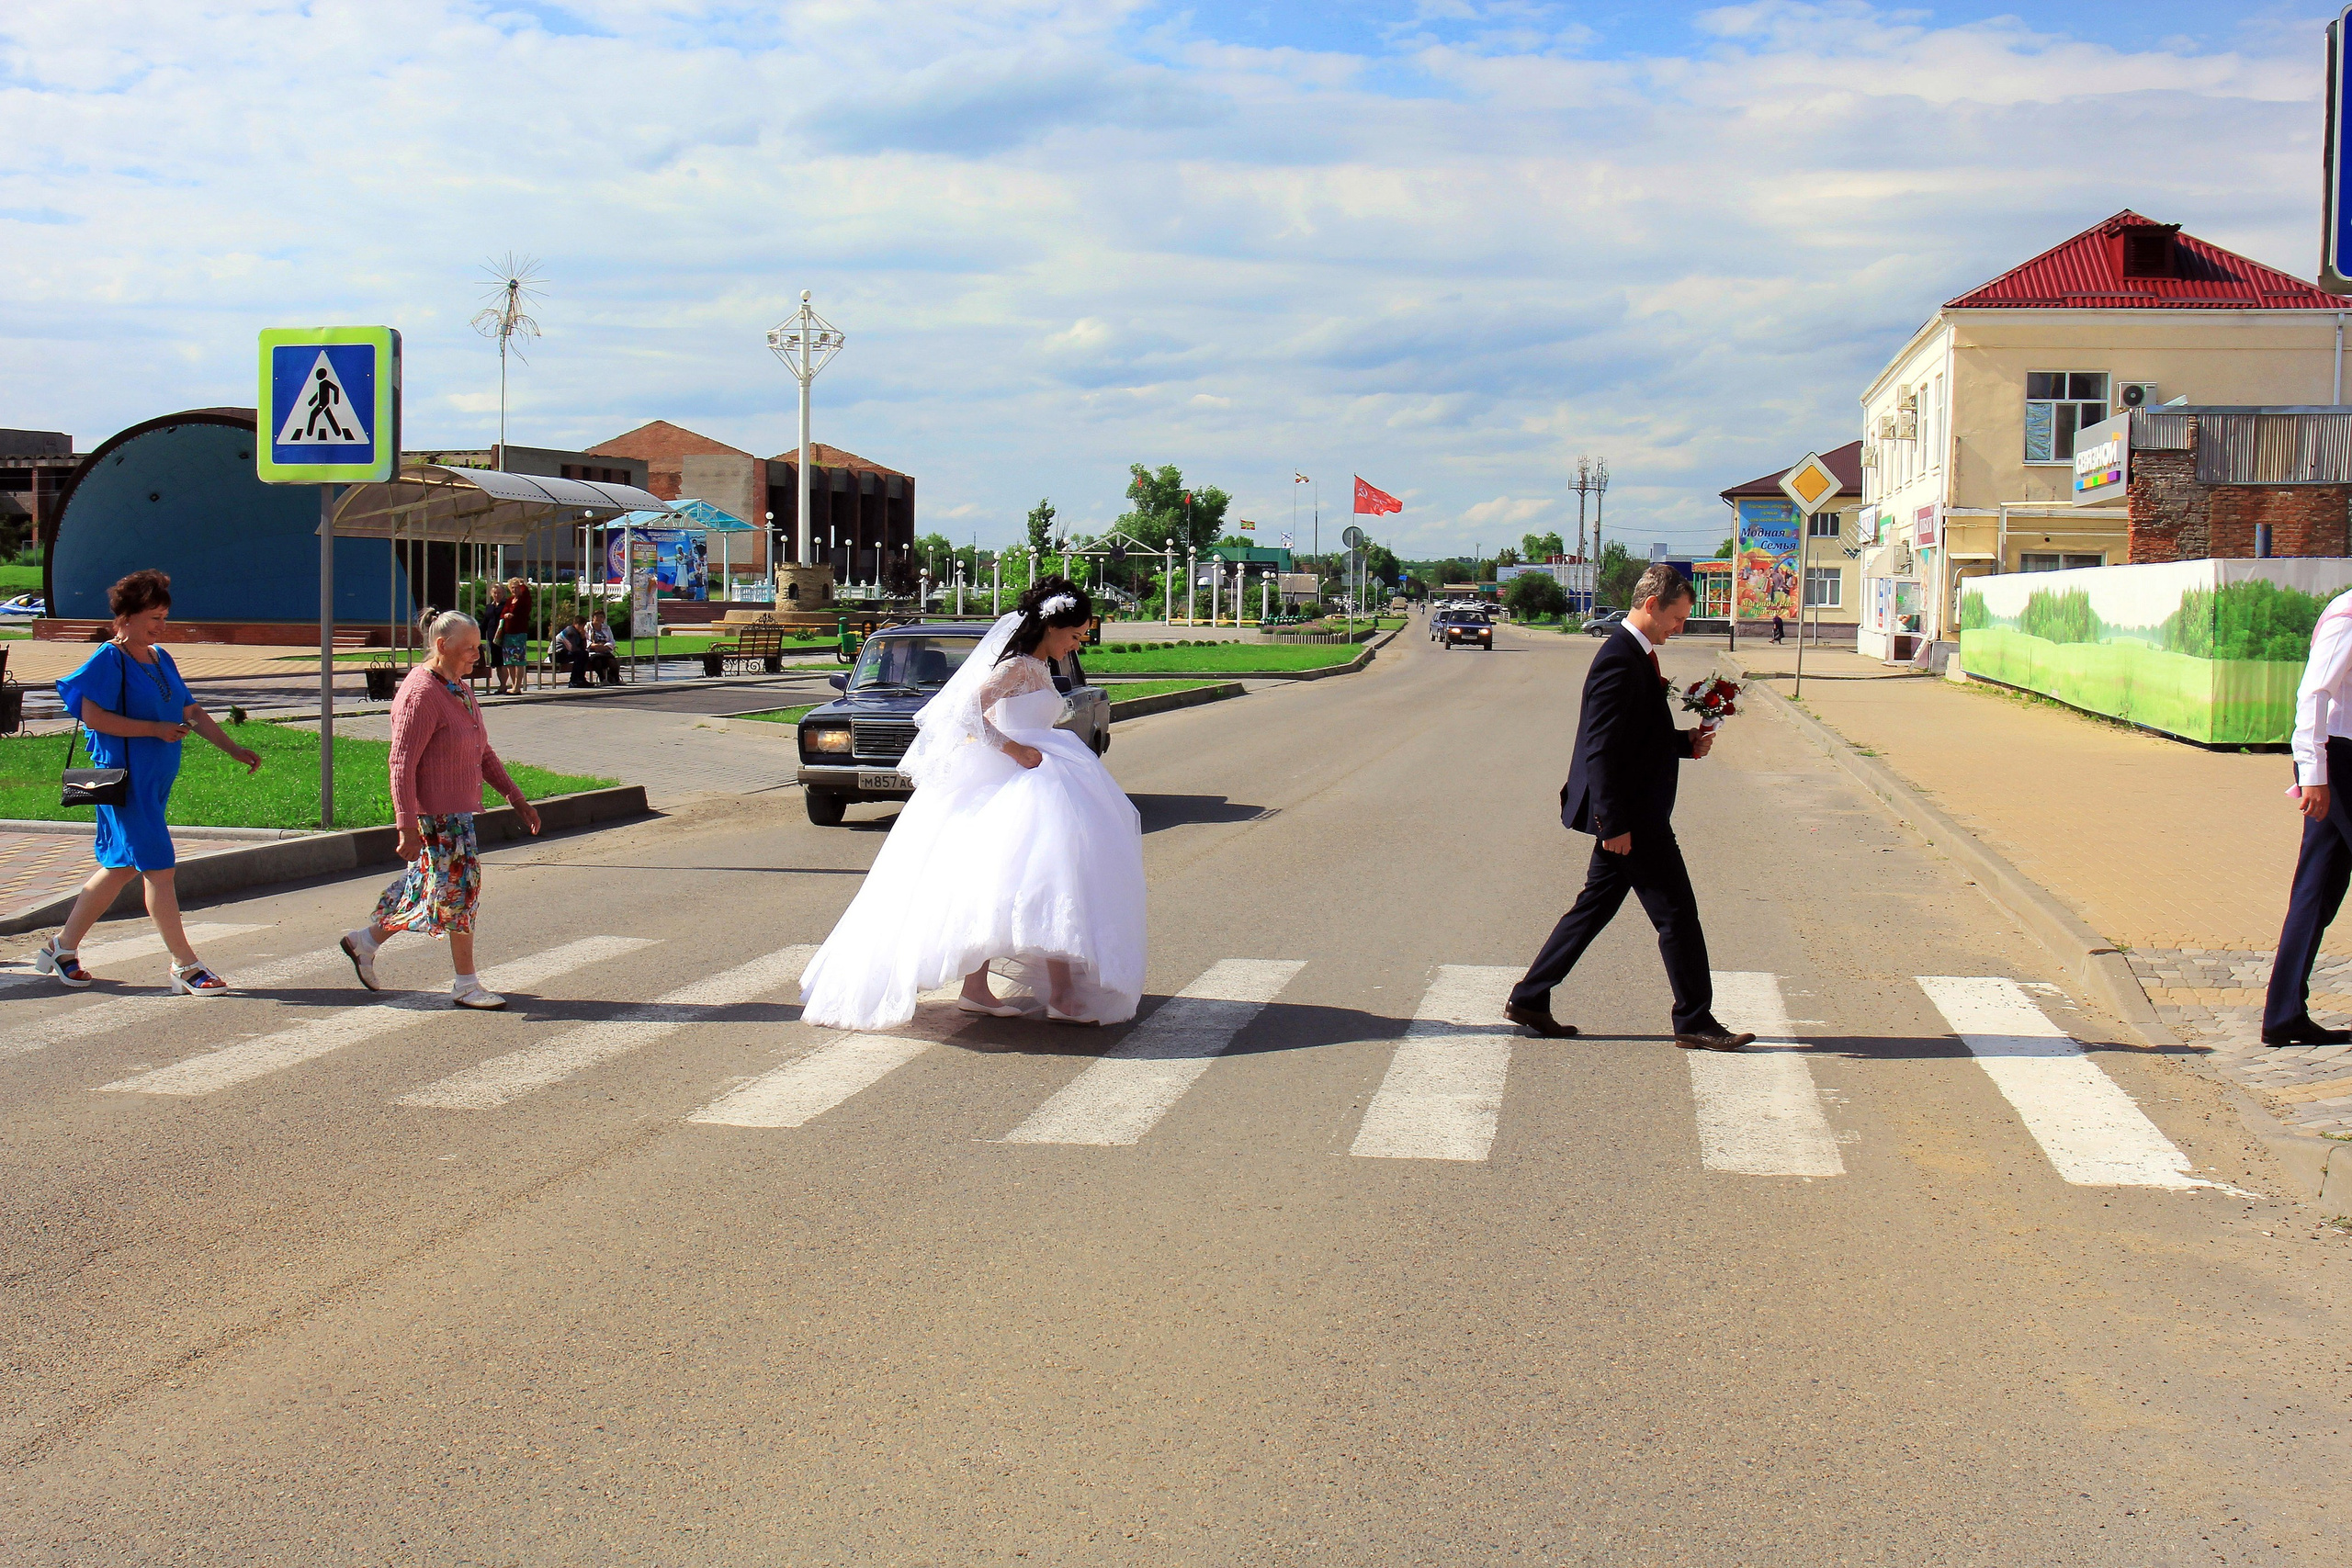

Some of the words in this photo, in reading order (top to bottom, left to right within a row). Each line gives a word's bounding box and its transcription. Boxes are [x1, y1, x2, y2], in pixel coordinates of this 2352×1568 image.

[2075, 433, 2121, 475] СВЯЗНОЙ
[1741, 528, 1785, 537] Модная
[1760, 540, 1796, 549] Семья
[1756, 600, 1778, 608] рады
[865, 776, 897, 788] М857
